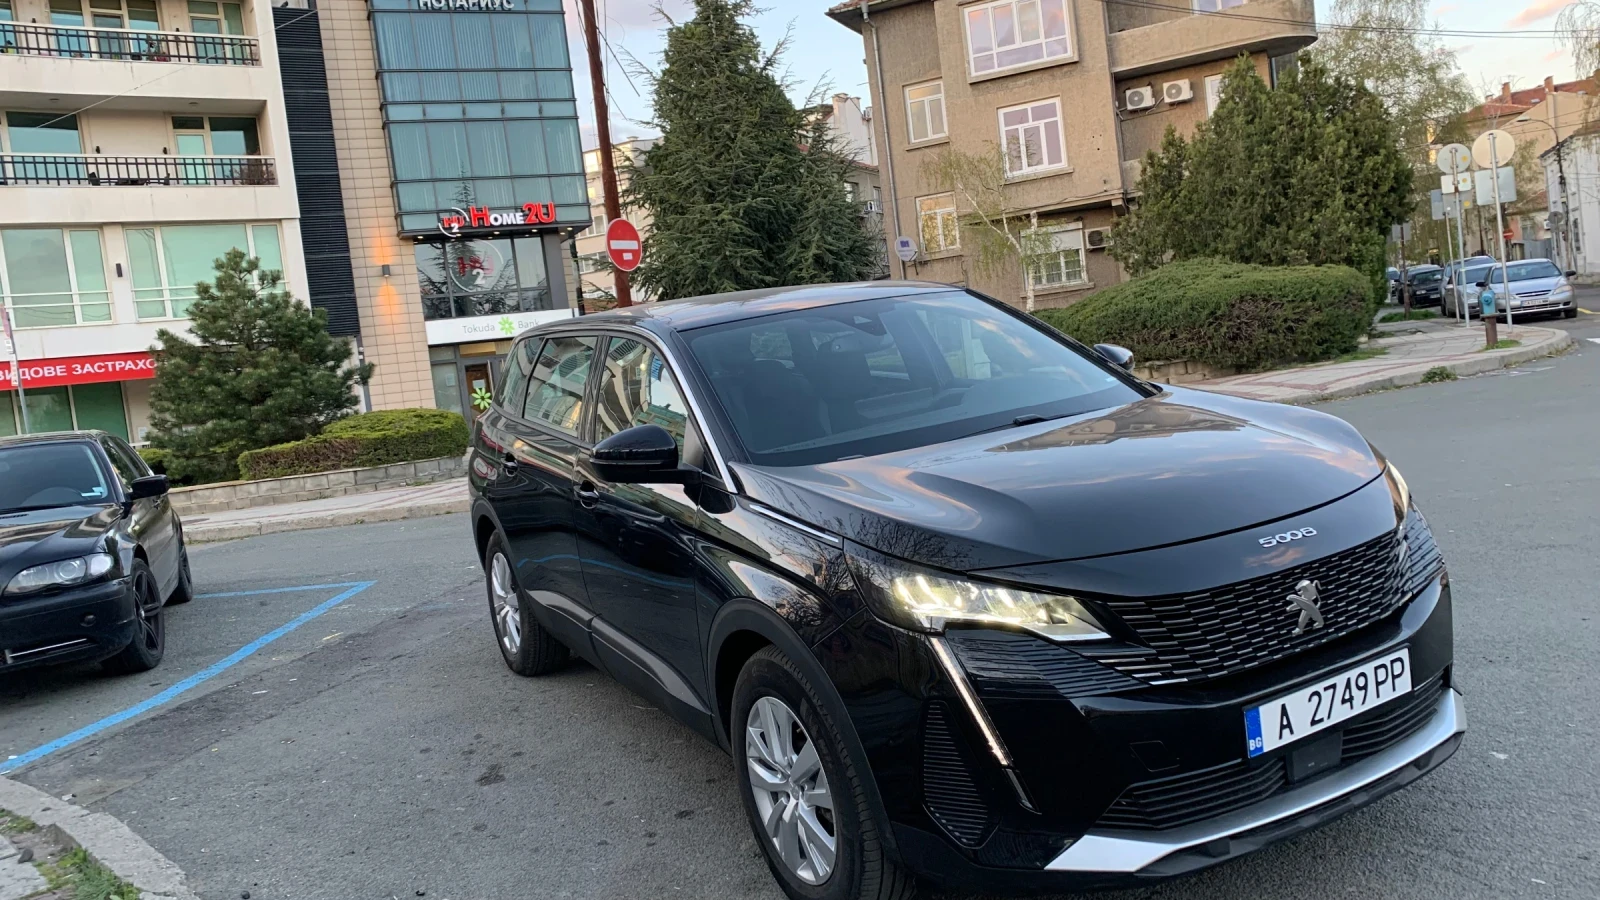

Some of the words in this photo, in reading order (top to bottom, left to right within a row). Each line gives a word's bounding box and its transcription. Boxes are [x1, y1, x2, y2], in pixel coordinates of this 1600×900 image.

[462, 323, 496, 334] Tokuda
[517, 318, 540, 329] Bank
[1258, 526, 1318, 548] 5008
[1278, 703, 1295, 740] A
[1249, 736, 1263, 751] BG
